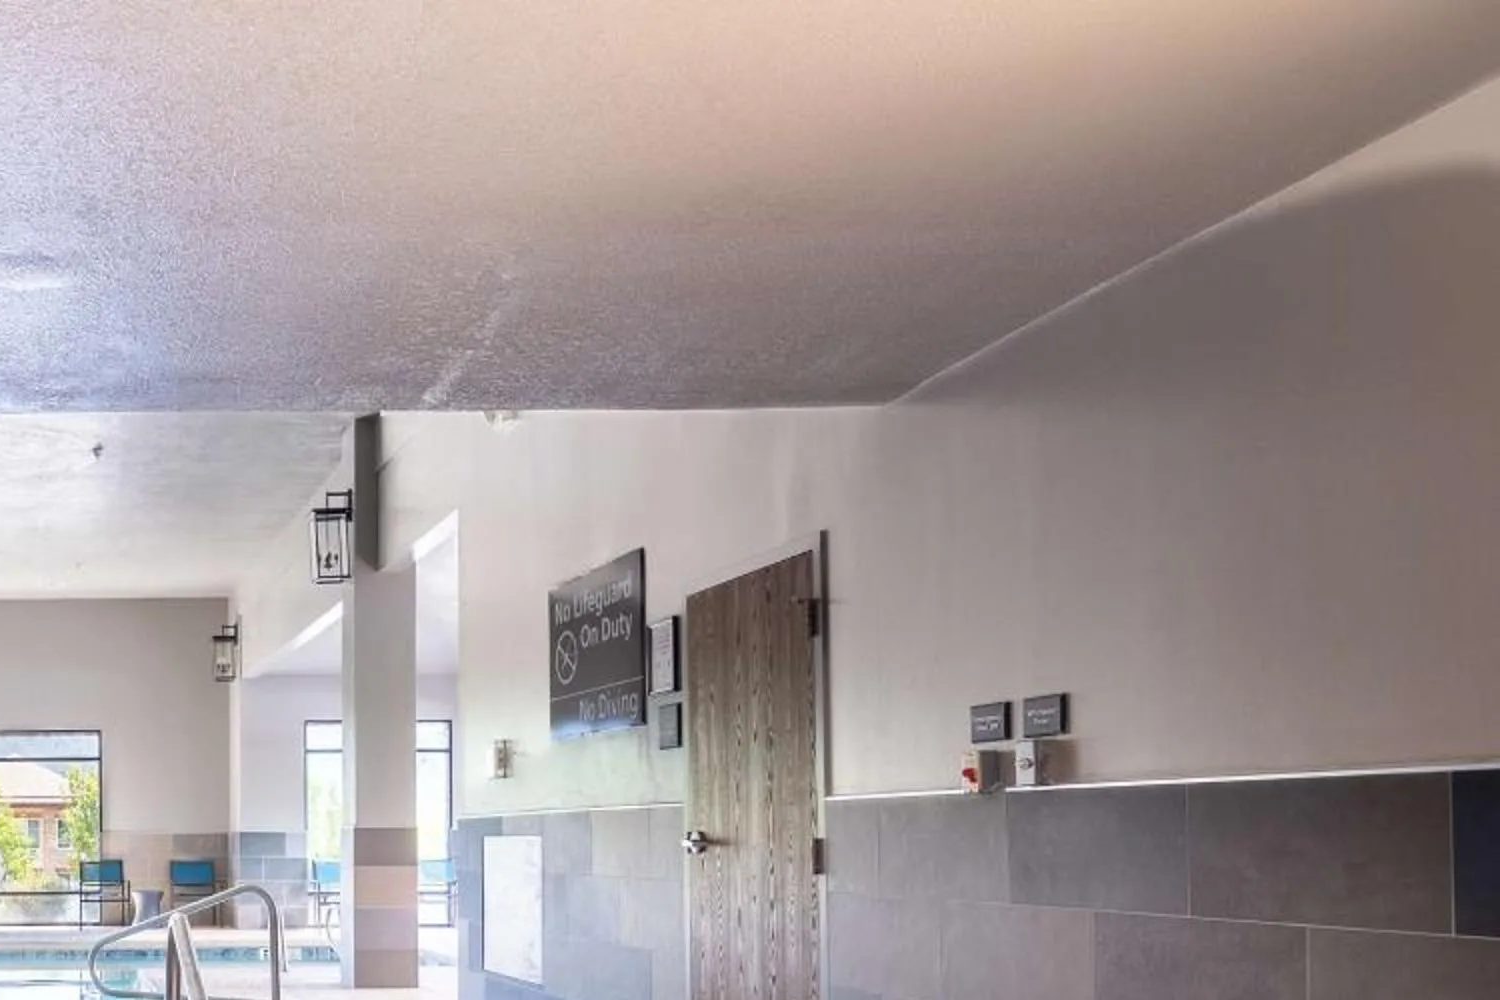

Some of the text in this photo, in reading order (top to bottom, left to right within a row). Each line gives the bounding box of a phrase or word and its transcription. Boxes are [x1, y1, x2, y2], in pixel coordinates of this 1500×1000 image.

[555, 570, 632, 626] No Lifeguard
[579, 612, 633, 649] On Duty
[578, 688, 639, 722] No Diving
